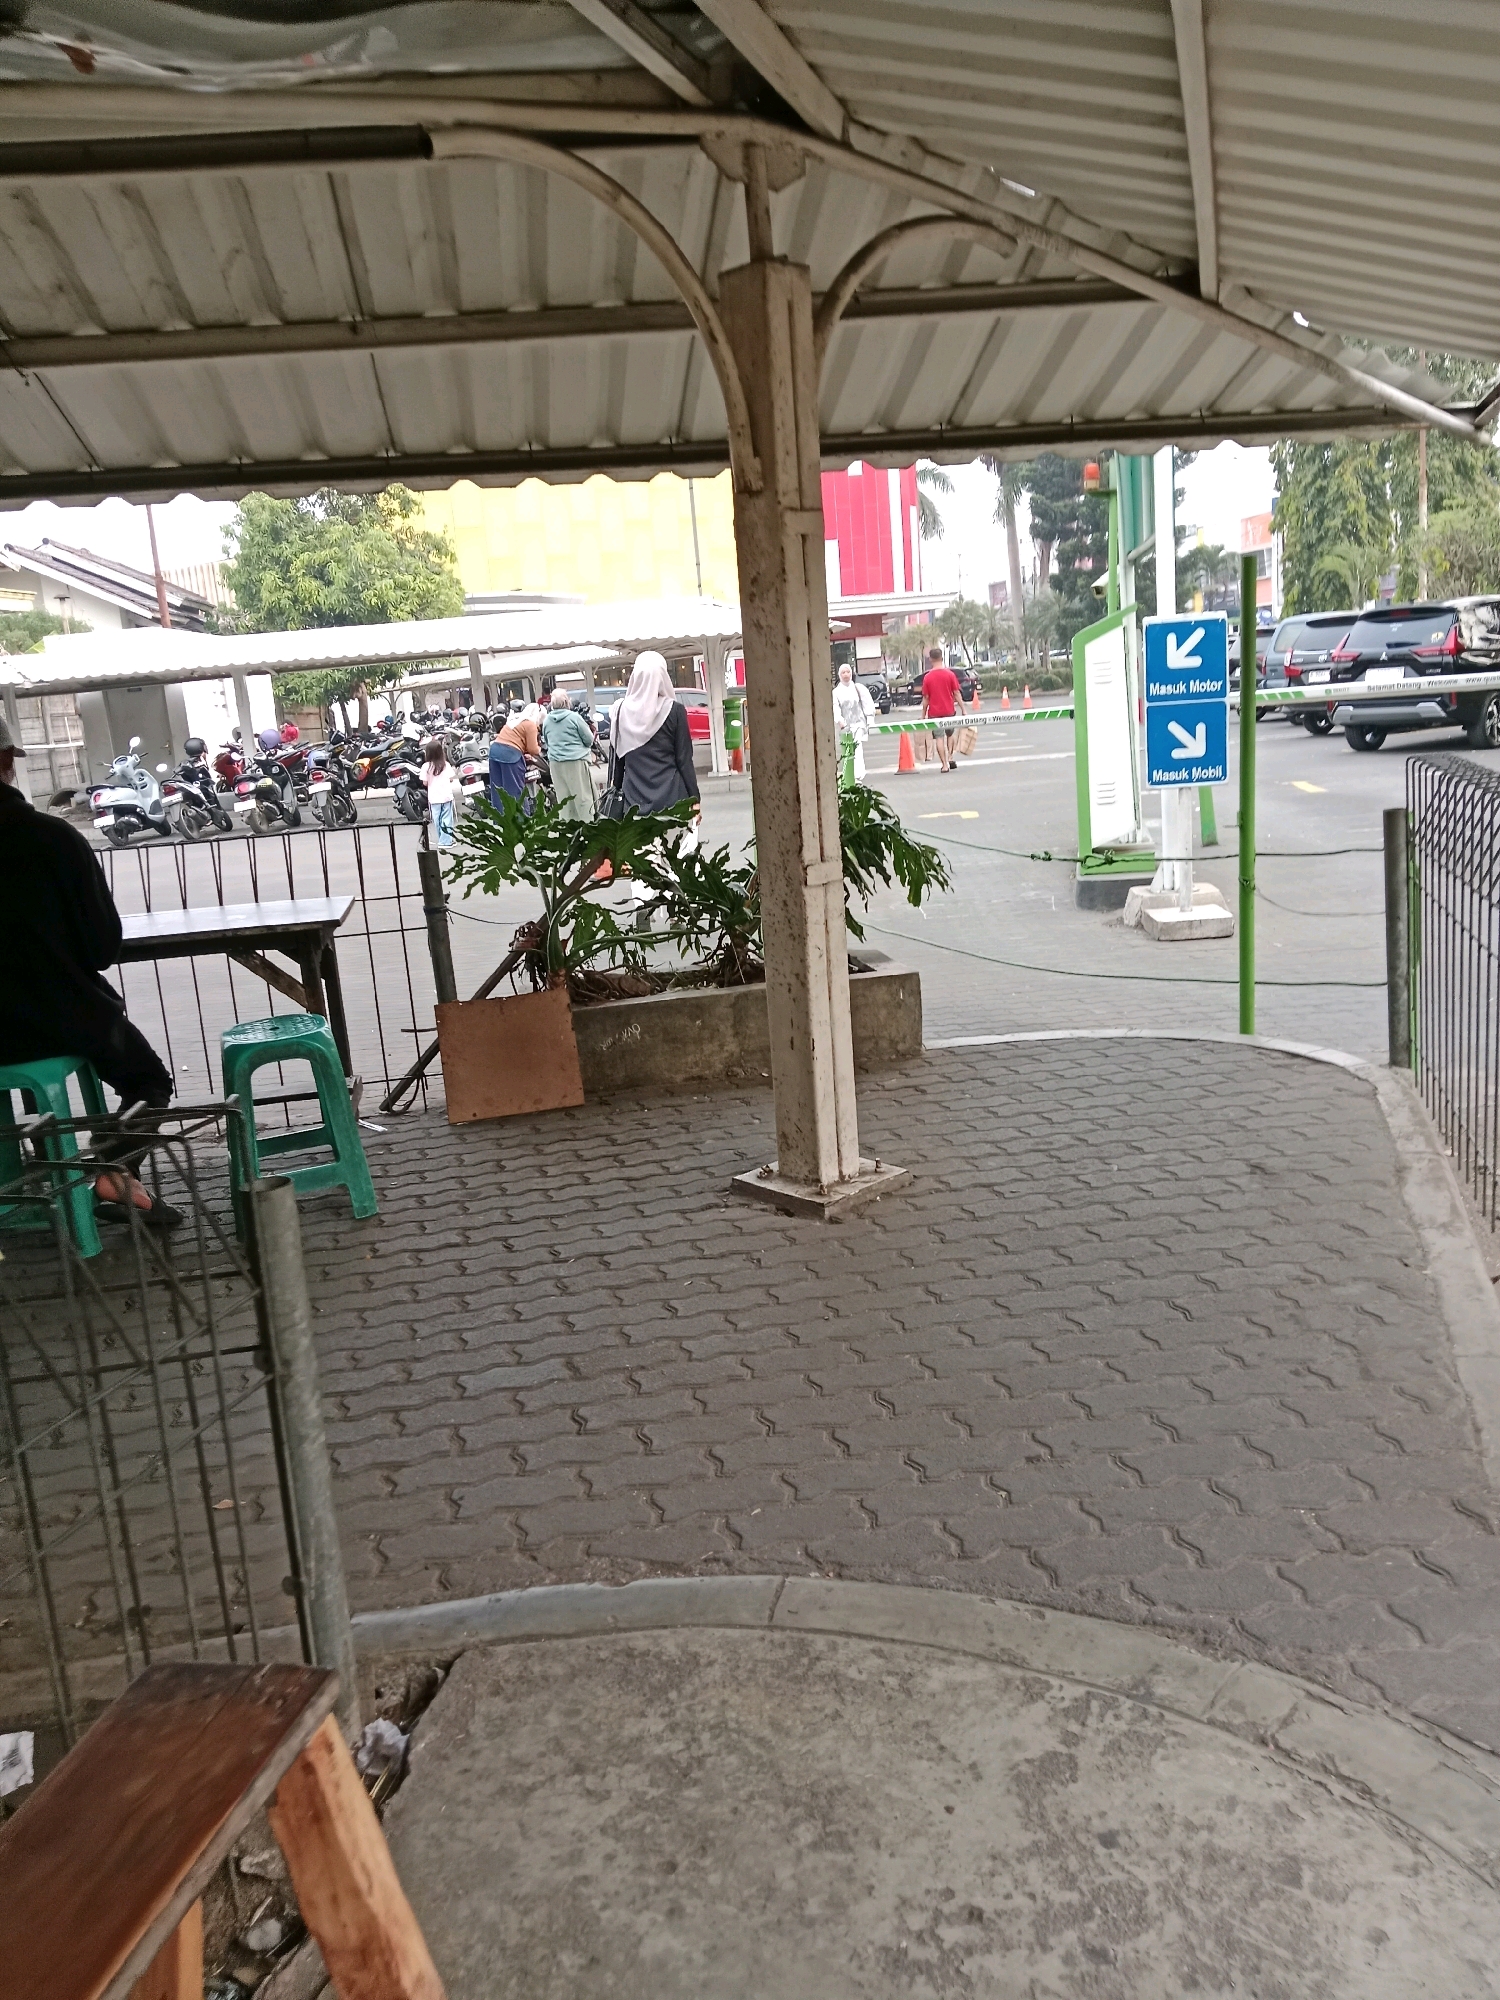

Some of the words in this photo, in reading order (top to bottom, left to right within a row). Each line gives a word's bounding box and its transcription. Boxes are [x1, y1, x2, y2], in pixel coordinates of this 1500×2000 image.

[1149, 681, 1187, 696] Masuk
[1189, 679, 1223, 693] Motor
[1367, 683, 1396, 692] Selamat
[1396, 681, 1422, 690] Datang
[939, 719, 964, 728] Selamat
[964, 716, 987, 725] Datang
[1152, 768, 1190, 782] Masuk
[1192, 765, 1223, 780] Mobil
